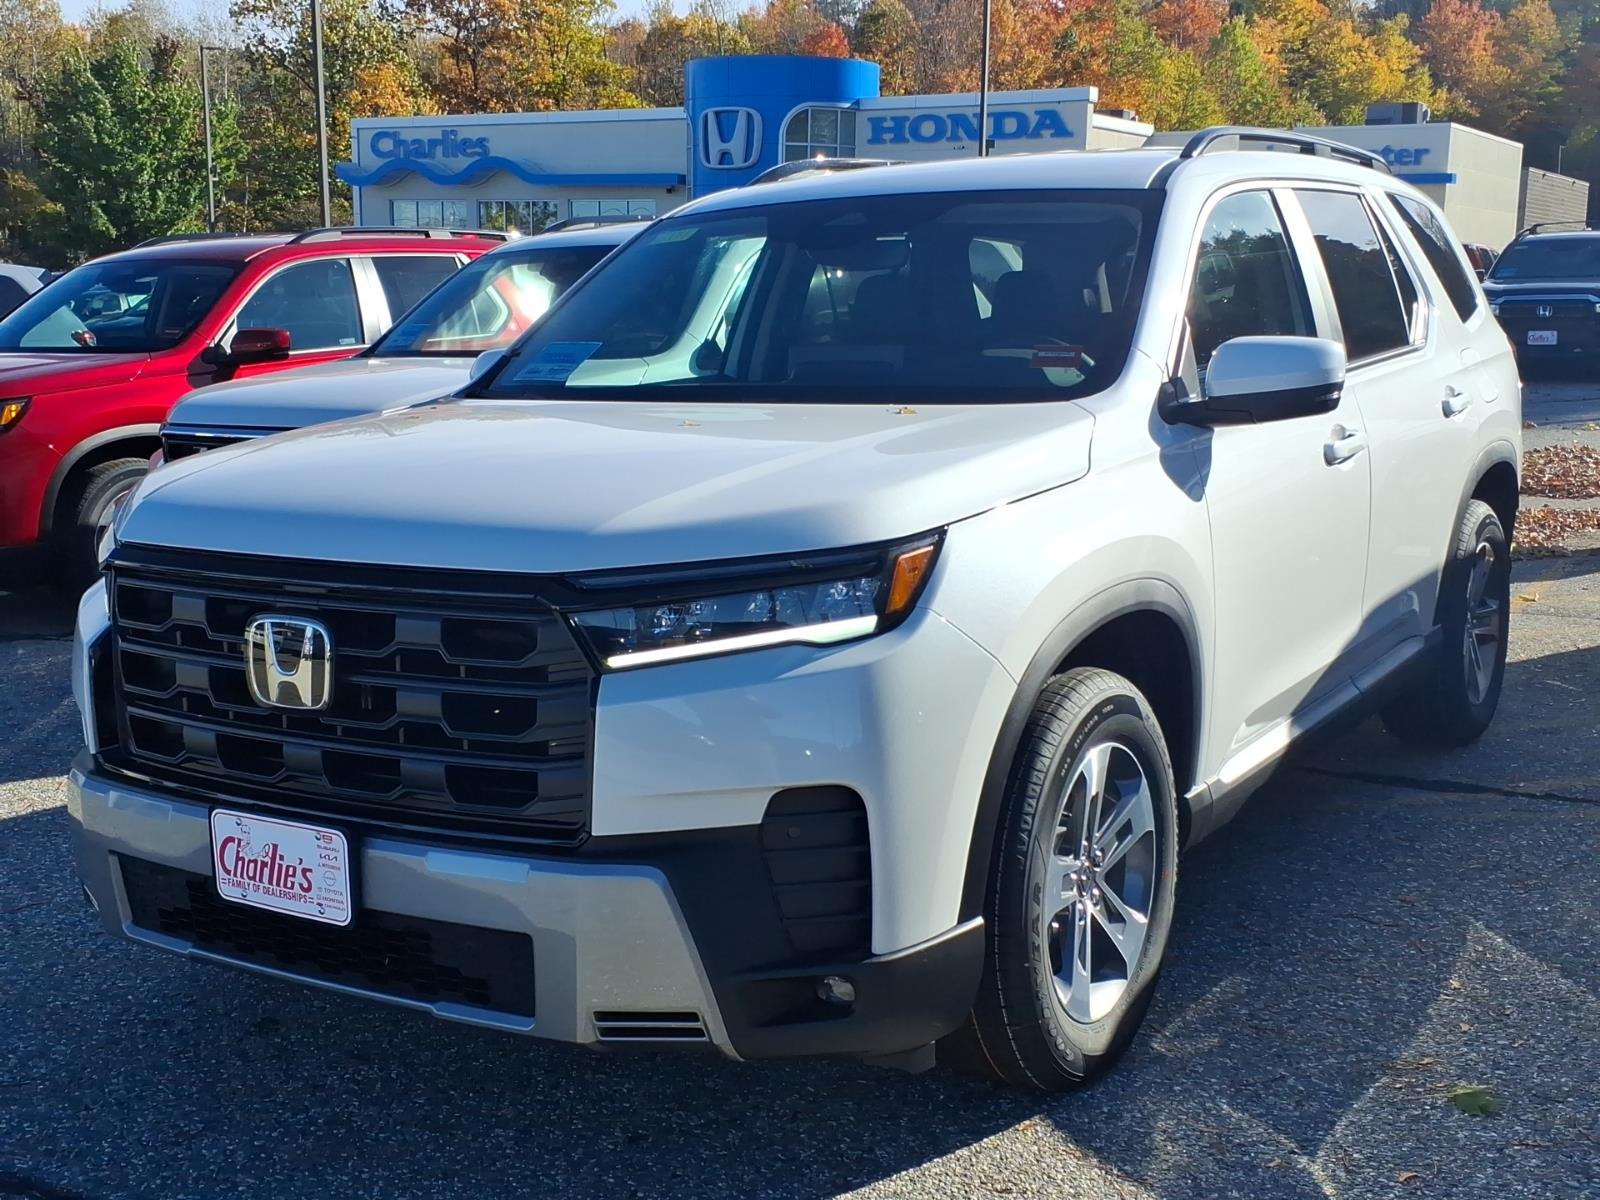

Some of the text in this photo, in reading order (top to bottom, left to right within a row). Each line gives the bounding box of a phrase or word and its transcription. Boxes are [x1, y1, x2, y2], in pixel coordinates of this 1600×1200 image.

[866, 109, 1075, 145] HONDA
[370, 129, 490, 160] Charlies
[1374, 144, 1431, 167] ter
[219, 835, 313, 894] Charlie's
[227, 878, 308, 904] FAMILY OF DEALERSHIPS
[324, 887, 343, 897] TOYOTA
